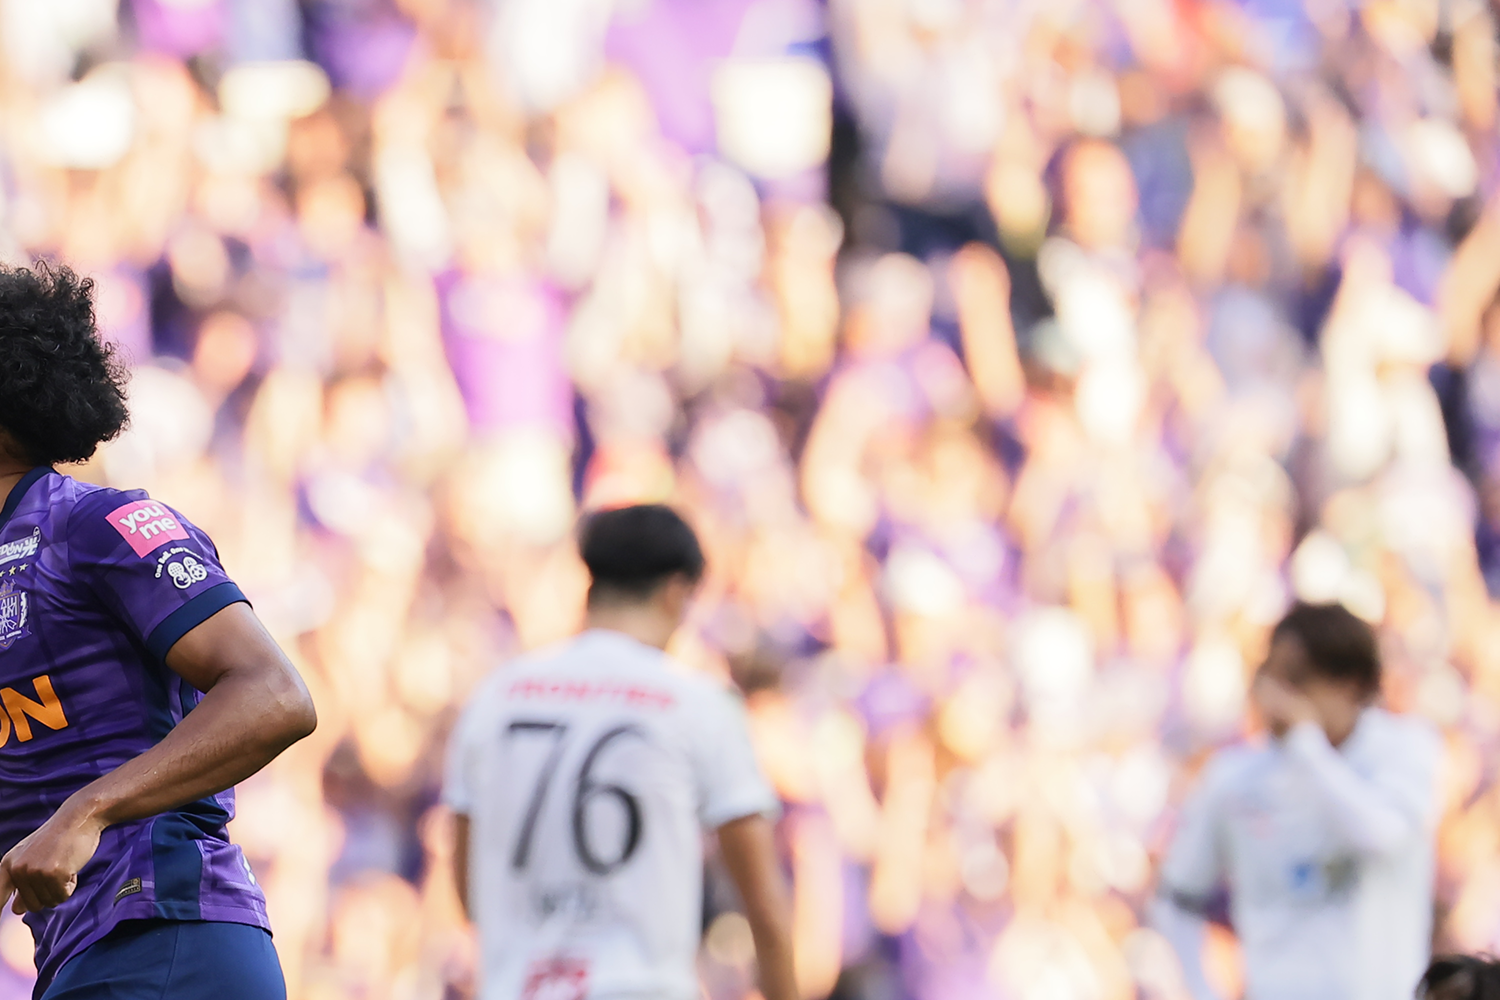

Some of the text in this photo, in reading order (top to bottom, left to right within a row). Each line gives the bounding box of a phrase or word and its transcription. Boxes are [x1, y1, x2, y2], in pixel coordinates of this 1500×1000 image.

[119, 505, 165, 535] you
[139, 517, 177, 540] me
[506, 720, 644, 877] 76
